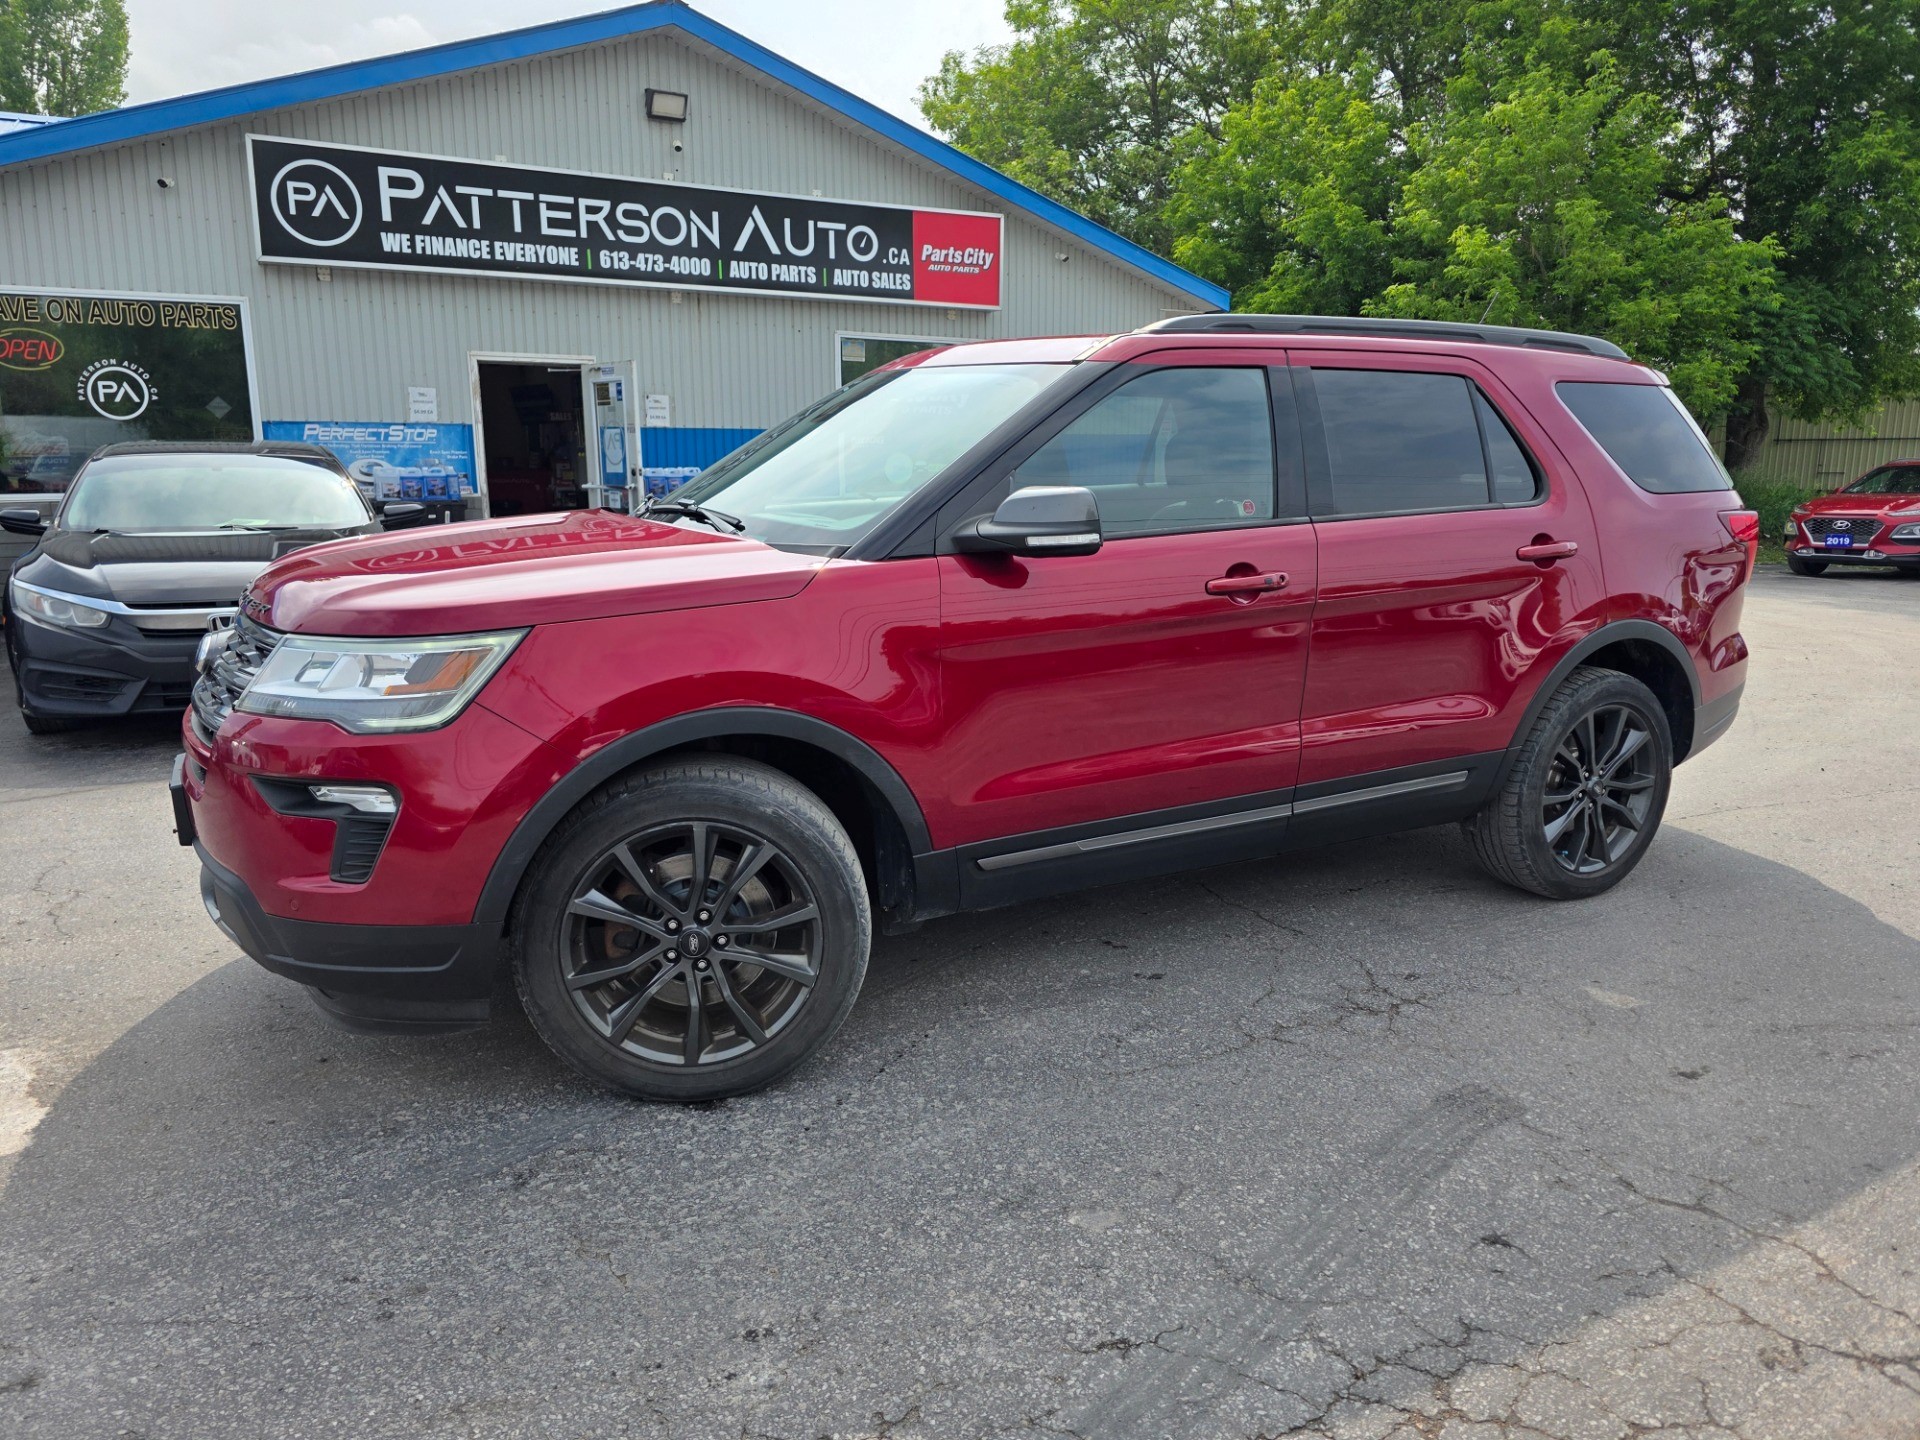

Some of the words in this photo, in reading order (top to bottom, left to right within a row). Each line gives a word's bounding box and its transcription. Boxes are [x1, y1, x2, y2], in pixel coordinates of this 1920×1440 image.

[286, 180, 350, 220] PA
[377, 165, 720, 250] PATTERSON
[733, 204, 879, 262] AUTO
[380, 232, 411, 253] WE
[415, 235, 491, 260] FINANCE
[494, 241, 580, 267] EVERYONE
[600, 250, 711, 277] 613-473-4000
[729, 260, 768, 281] AUTO
[771, 263, 817, 285] PARTS
[832, 268, 870, 288] AUTO
[872, 271, 911, 291] SALES
[928, 264, 952, 273] AUTO
[953, 265, 980, 275] PARTS
[45, 298, 83, 324] ON
[88, 300, 155, 327] AUTO
[160, 302, 237, 330] PARTS
[0, 338, 57, 361] OPEN
[77, 358, 117, 401] PATTERSON
[122, 360, 150, 379] AUTO
[97, 380, 141, 403] PA
[1826, 537, 1850, 545] 2019
